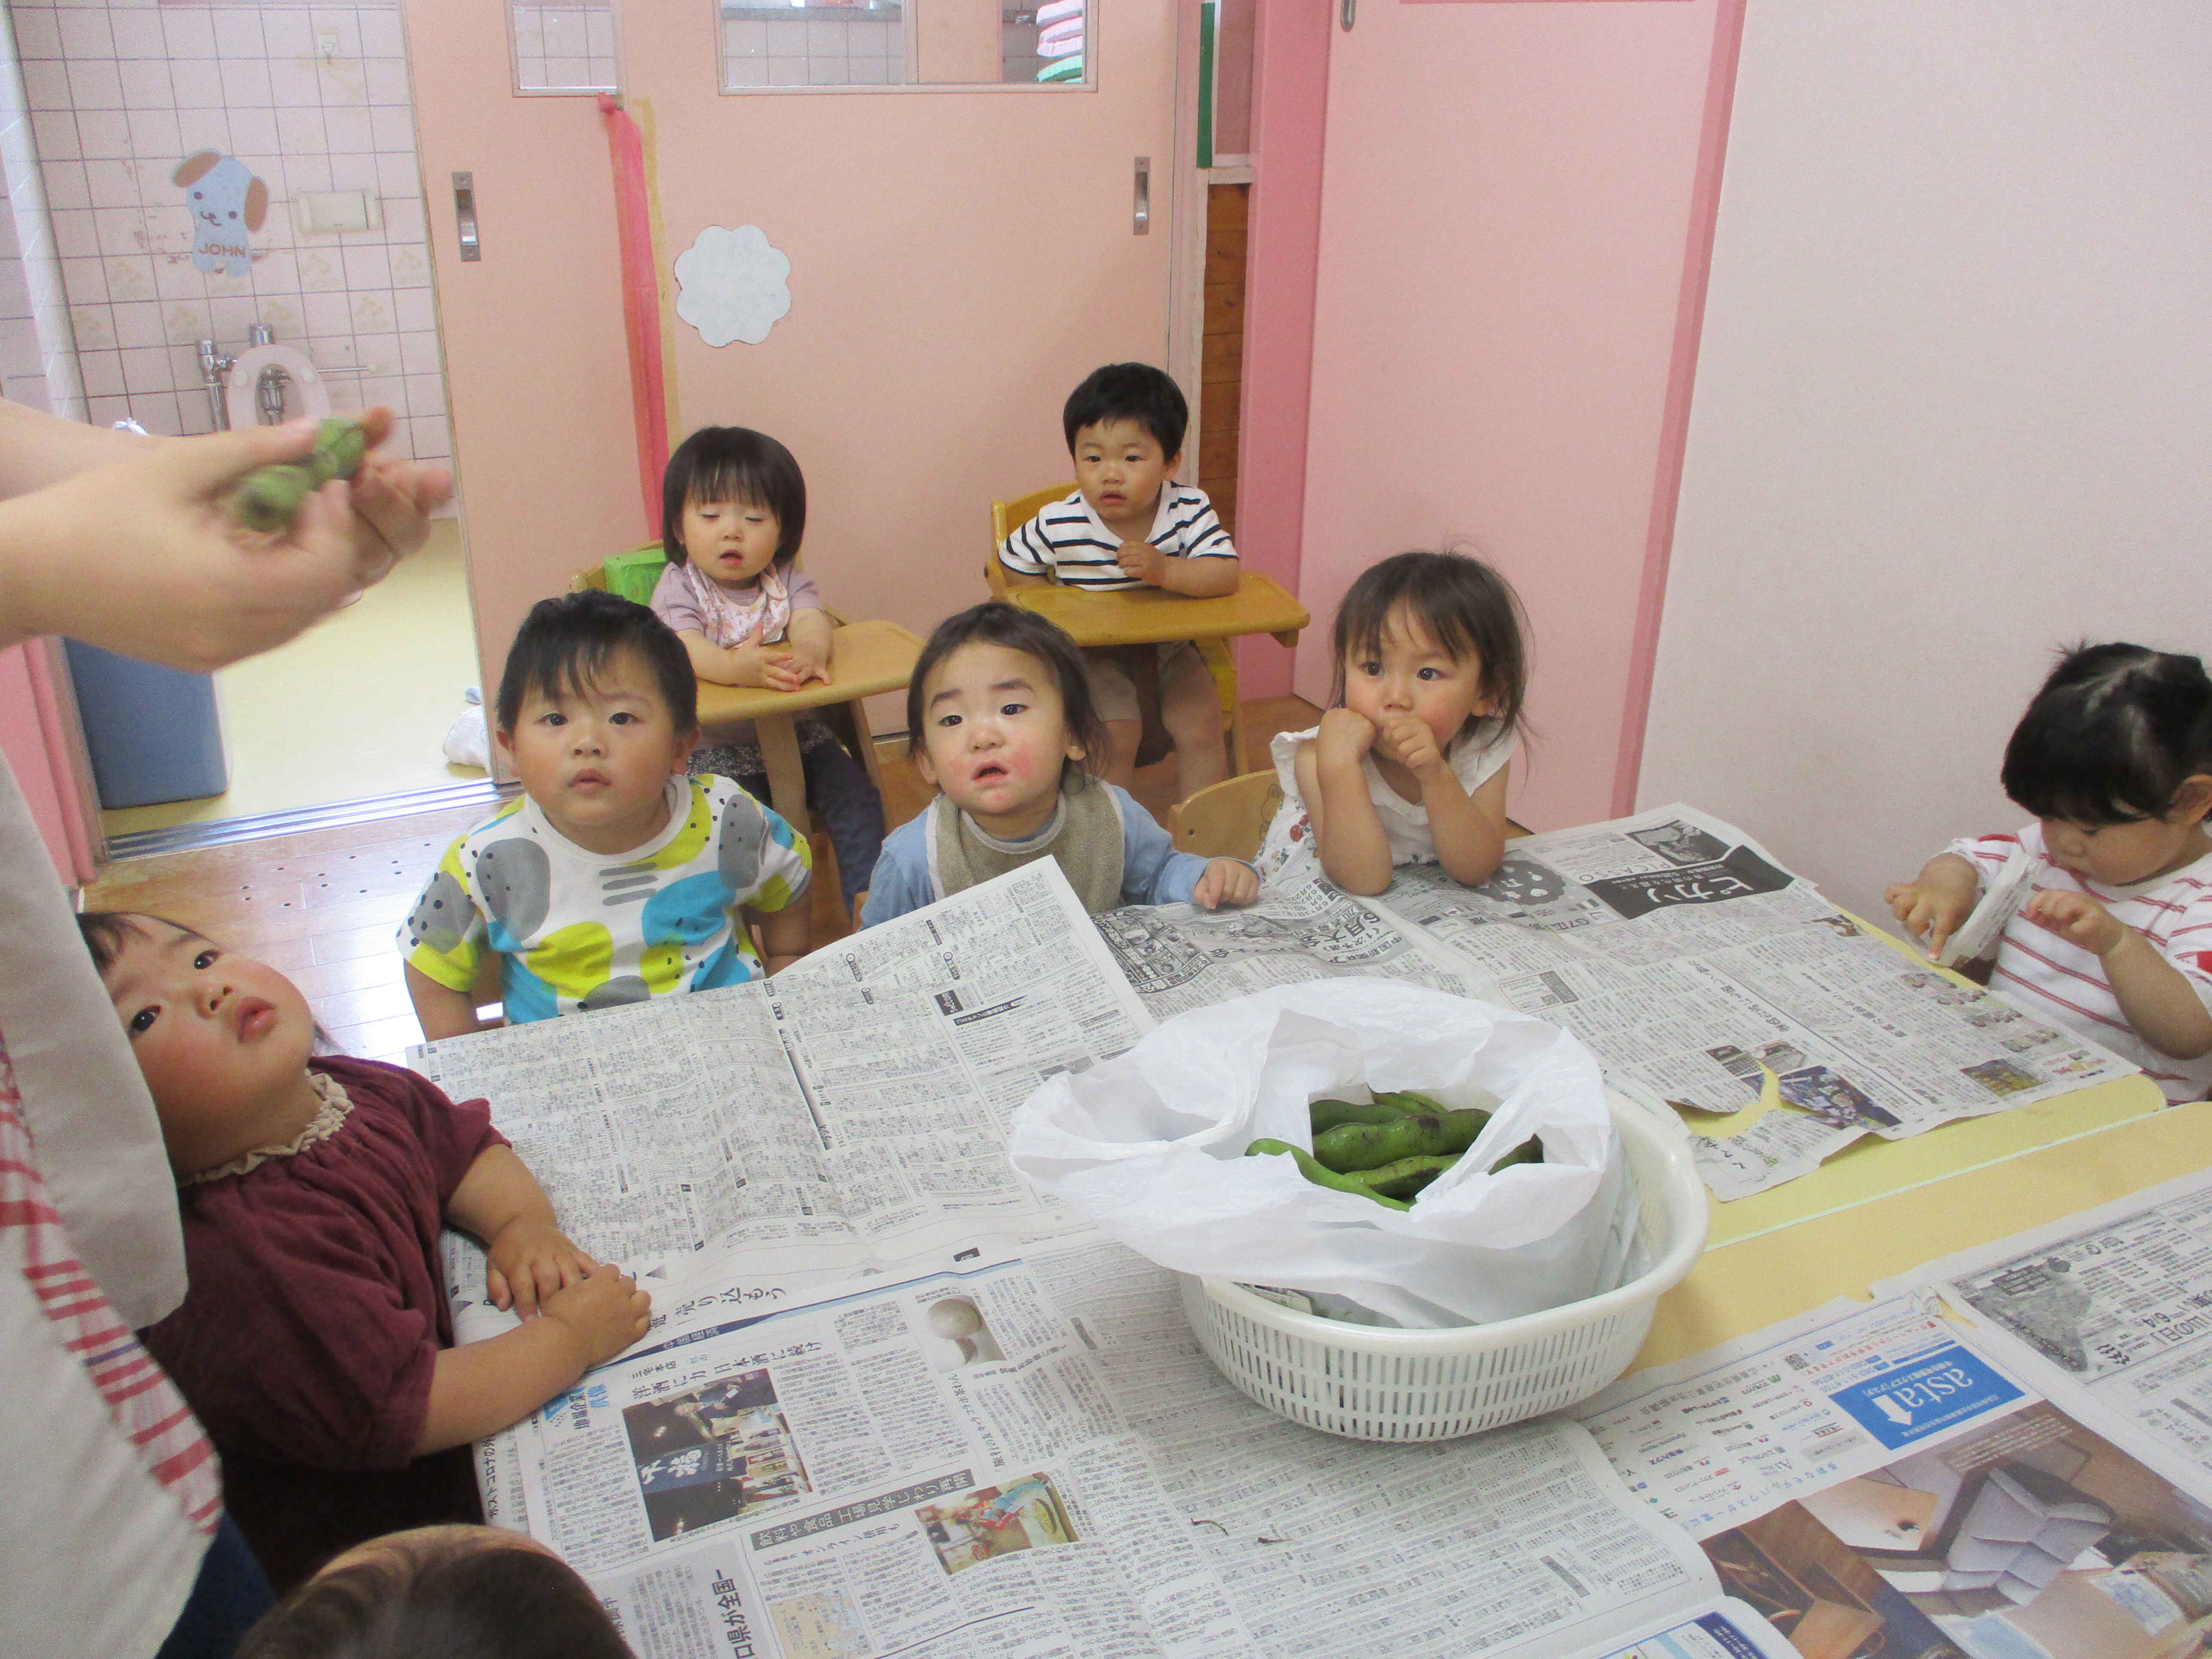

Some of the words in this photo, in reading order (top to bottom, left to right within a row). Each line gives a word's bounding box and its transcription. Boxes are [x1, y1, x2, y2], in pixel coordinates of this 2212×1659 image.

[199, 243, 246, 258] JOHN
[1647, 876, 1754, 903] ピカソ
[675, 1287, 786, 1316] 売り込もう
[662, 1327, 718, 1349] 中国経済
[631, 1361, 676, 1379] 三宅本店
[632, 1370, 707, 1400] 洋酒に力
[714, 1342, 823, 1373] 日本酒に続け
[1894, 1368, 1973, 1408] asta
[759, 1513, 834, 1547] 飲料や食品
[839, 1475, 971, 1522] 工場見学じわり再開
[802, 1523, 899, 1556] オンライン併用も
